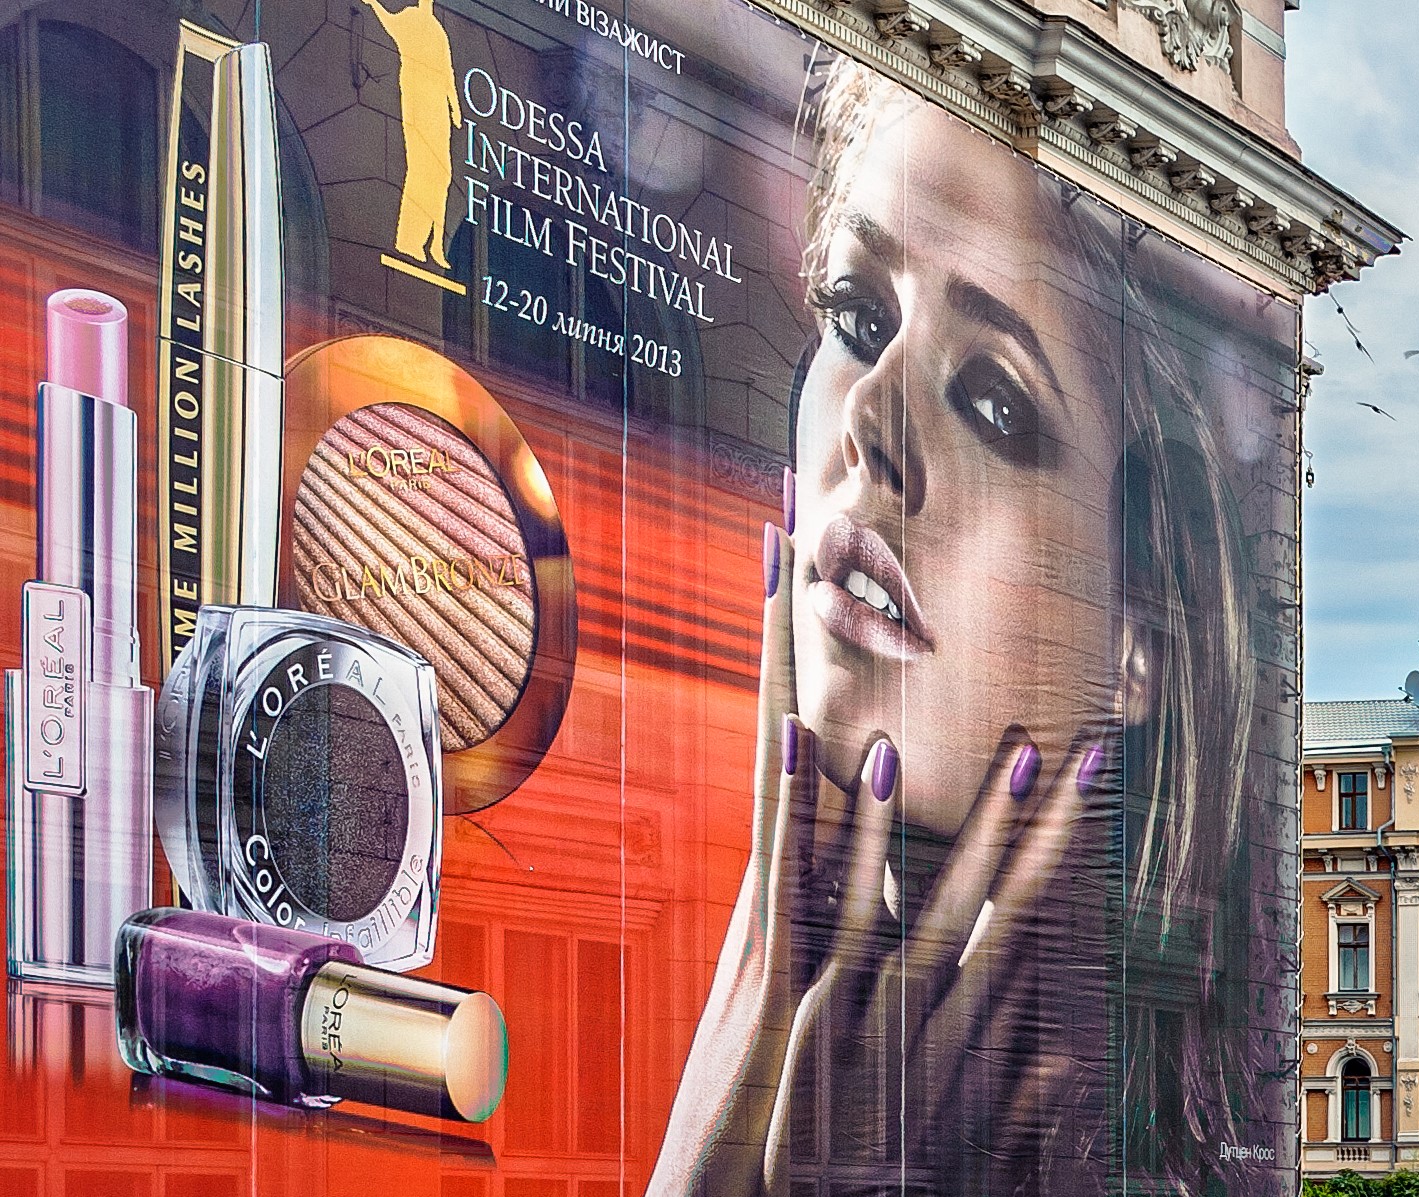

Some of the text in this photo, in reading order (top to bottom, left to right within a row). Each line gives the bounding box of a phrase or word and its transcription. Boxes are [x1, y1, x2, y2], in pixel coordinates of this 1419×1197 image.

[576, 0, 685, 75] ВІЗАЖИСТ
[463, 67, 608, 173] ODESSA
[176, 160, 207, 333] LASHES
[463, 119, 742, 284] INTERNATIONAL
[463, 176, 715, 323] FILM FESTIVAL
[481, 275, 683, 377] 12-20 липня 2013
[173, 356, 200, 554] MILLION
[174, 578, 198, 652] ME
[40, 599, 65, 779] L'ORÉAL
[64, 663, 75, 719] PARIS
[246, 649, 387, 760] L'ORÉAL
[327, 973, 357, 1074] L'ORÉA
[1219, 1141, 1275, 1163] Дутцен Крос
